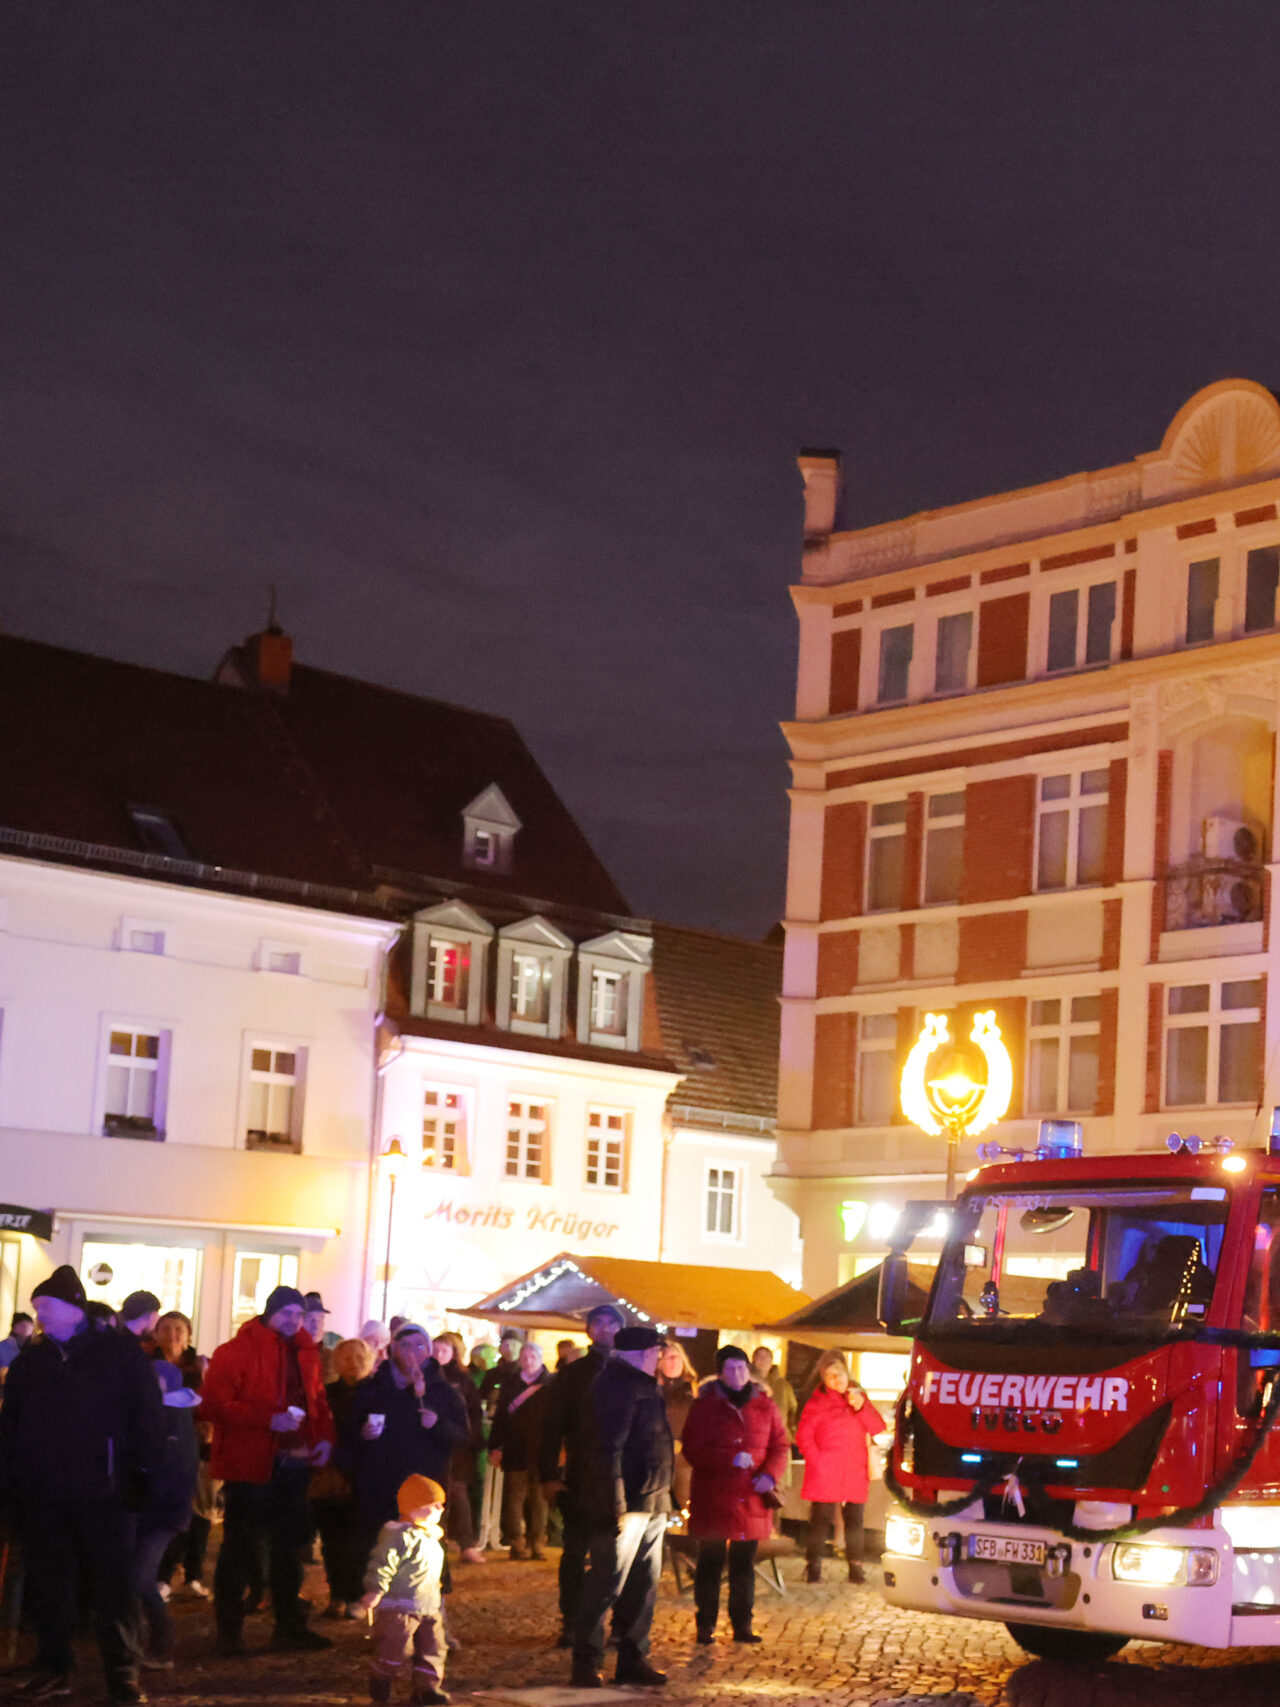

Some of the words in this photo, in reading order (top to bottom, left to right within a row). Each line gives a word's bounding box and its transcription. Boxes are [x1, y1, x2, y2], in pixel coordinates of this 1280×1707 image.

[424, 1201, 514, 1229] Moritz
[527, 1206, 619, 1240] Krüger
[924, 1371, 1128, 1411] FEUERWEHR
[971, 1407, 1062, 1434] IVECO
[975, 1539, 997, 1557] SFB
